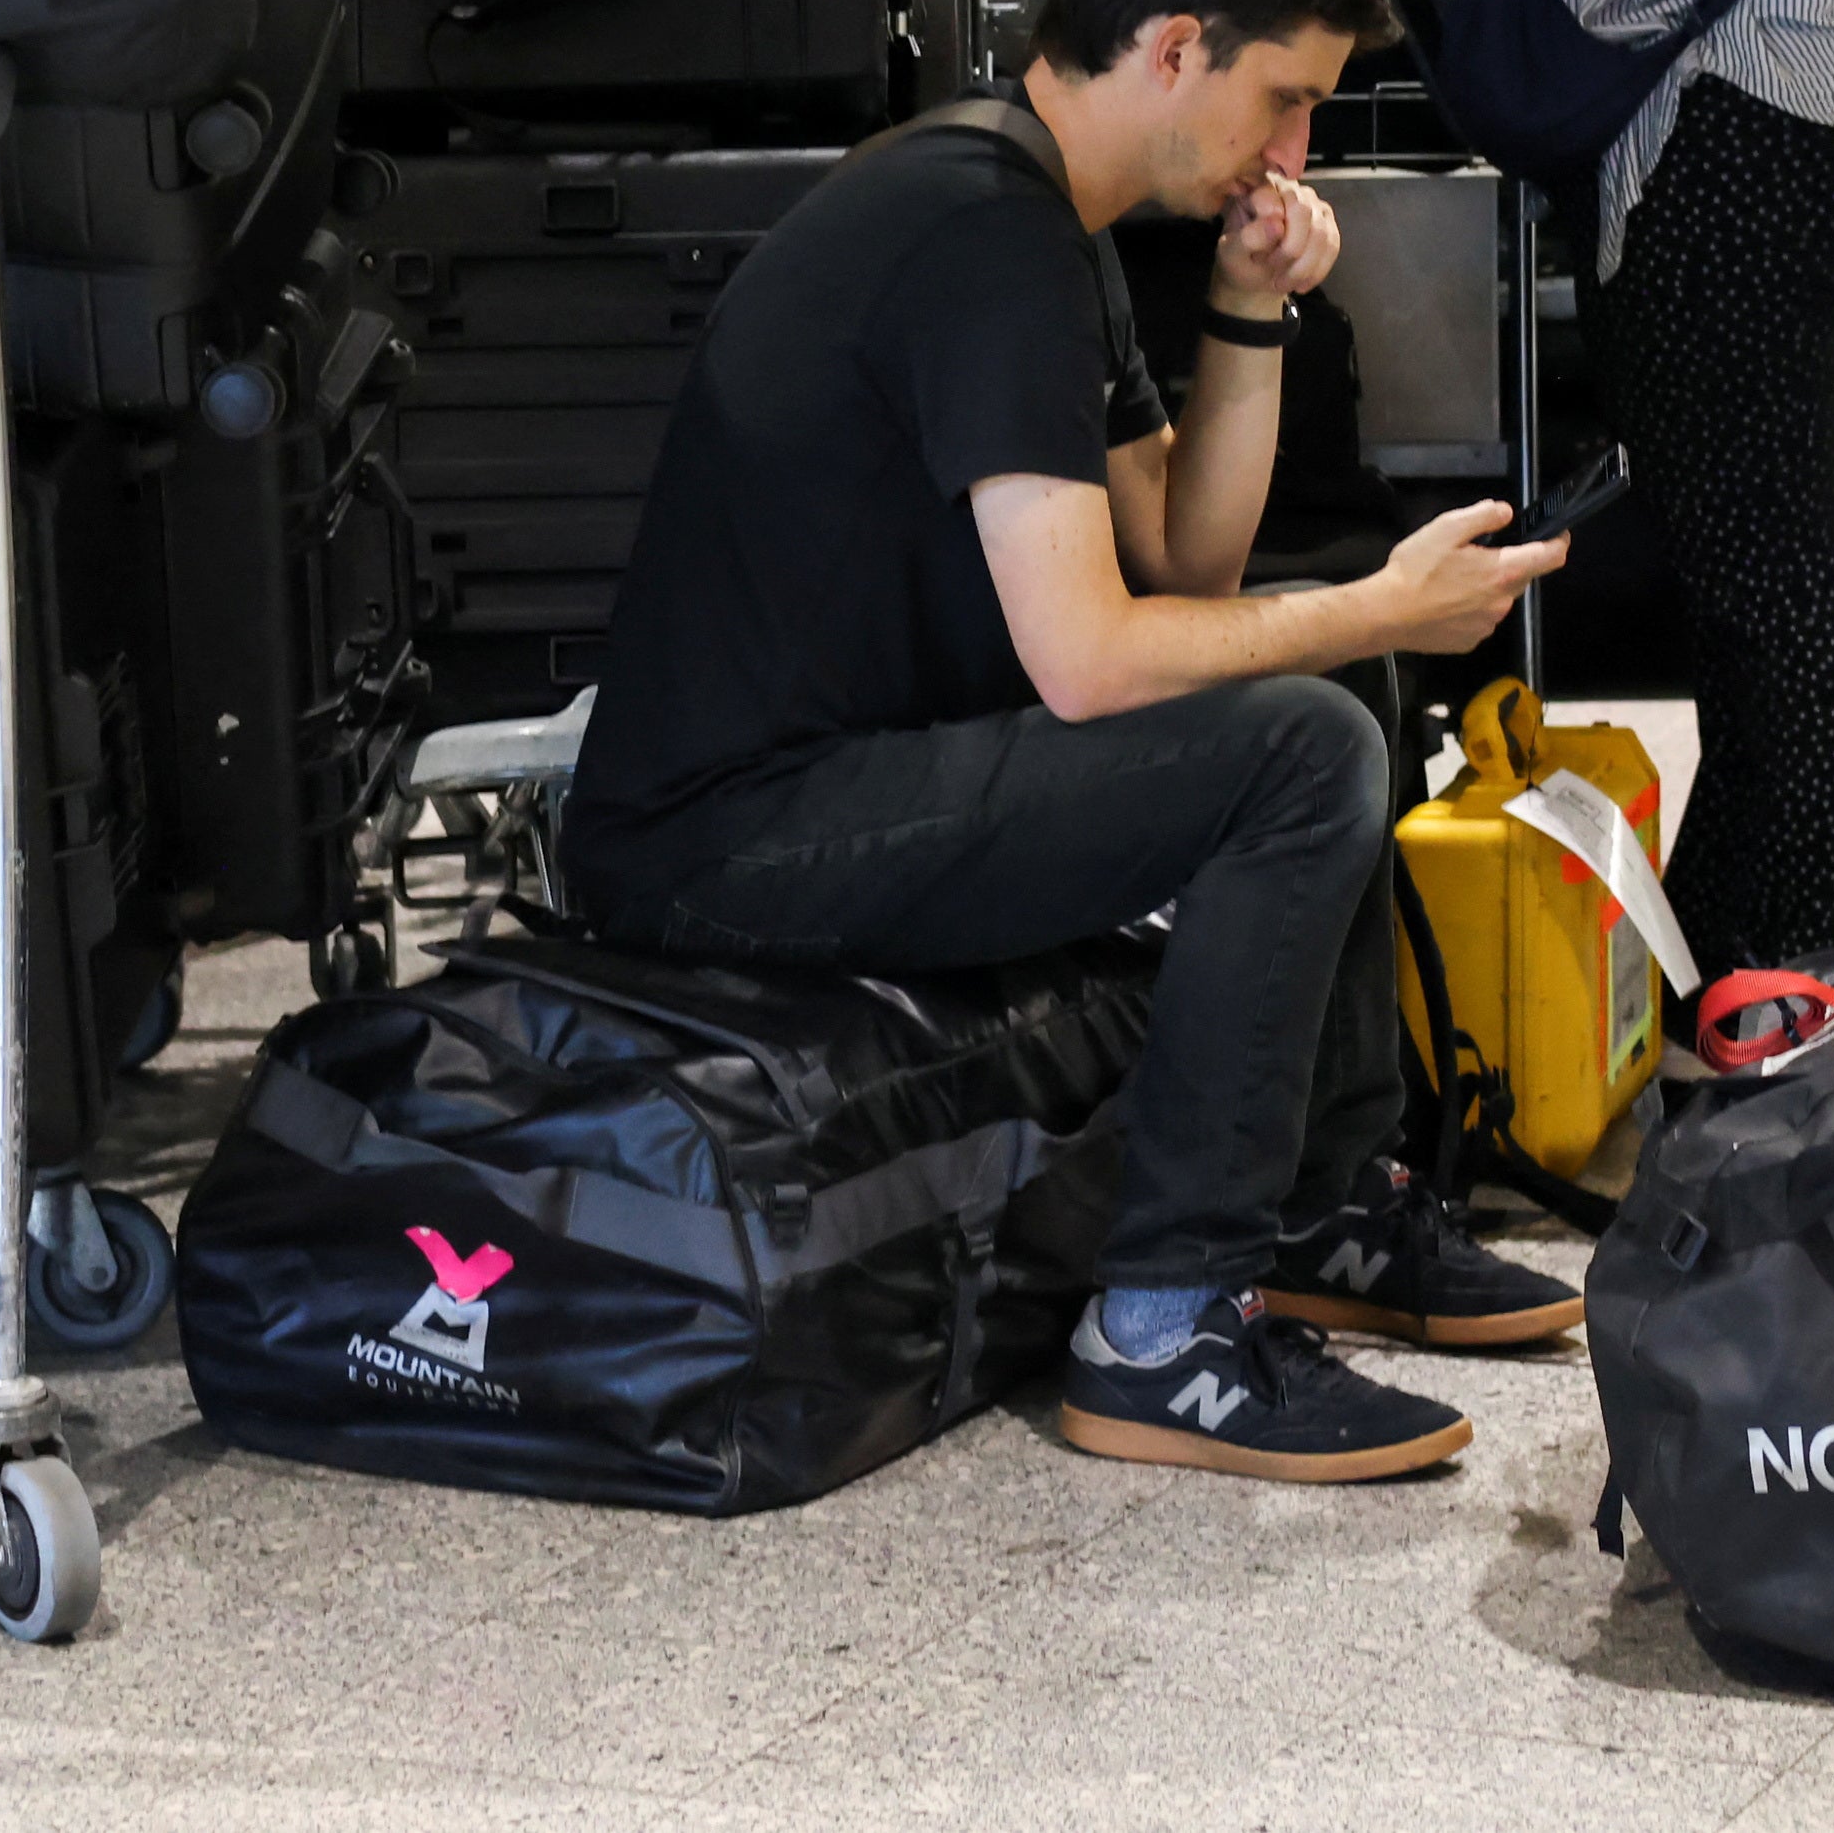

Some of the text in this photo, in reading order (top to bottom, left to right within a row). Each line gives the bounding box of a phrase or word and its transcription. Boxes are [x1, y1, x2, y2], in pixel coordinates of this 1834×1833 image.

[1318, 1238, 1391, 1293] N
[346, 1333, 521, 1404] MOUNTAIN
[1167, 1368, 1250, 1432] N
